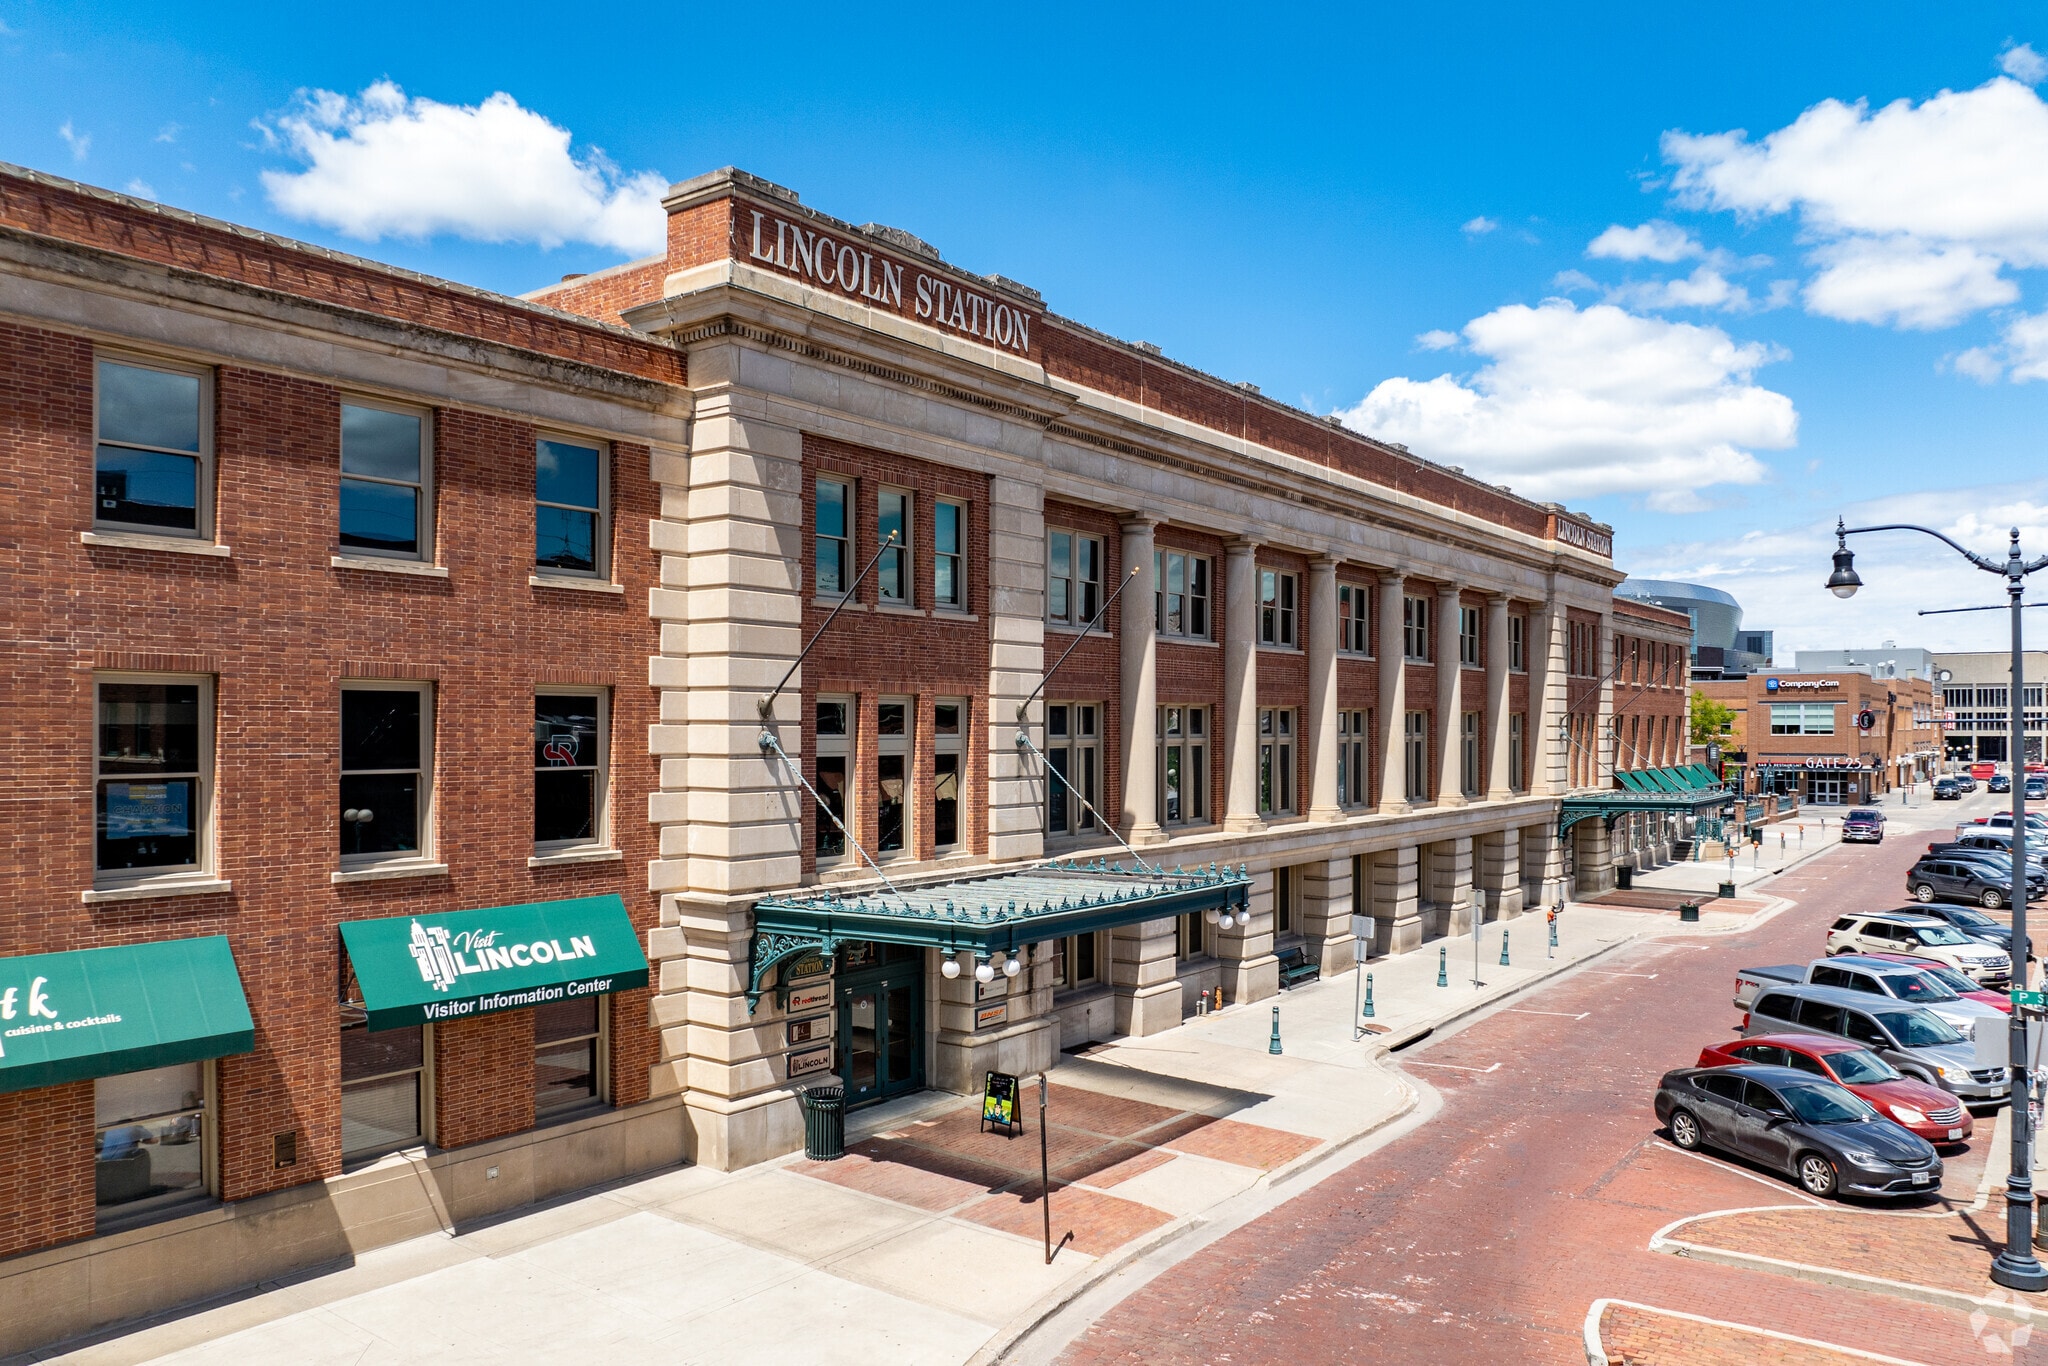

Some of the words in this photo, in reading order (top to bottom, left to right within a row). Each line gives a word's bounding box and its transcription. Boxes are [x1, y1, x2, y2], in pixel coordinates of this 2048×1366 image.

[750, 209, 904, 308] LINCOLN
[915, 273, 1030, 352] STATION
[1557, 518, 1586, 547] LINCOLN
[1586, 530, 1611, 557] STATION
[1780, 680, 1839, 688] CompanyCam
[1806, 758, 1840, 769] GATE
[1845, 757, 1862, 769] 25
[113, 803, 182, 815] CHAMPION
[453, 928, 504, 953] Visit
[454, 935, 597, 975] LINCOLN
[796, 959, 824, 975] STATION
[424, 999, 476, 1019] Visitor
[480, 985, 563, 1011] Information
[567, 977, 612, 996] Center
[801, 993, 829, 1004] redthread
[2019, 992, 2028, 1001] P
[980, 1008, 1004, 1019] BNSF
[5, 1025, 52, 1037] cuisine
[54, 1021, 64, 1031] &
[66, 1013, 122, 1029] cocktails
[798, 1057, 828, 1070] LINCOLN
